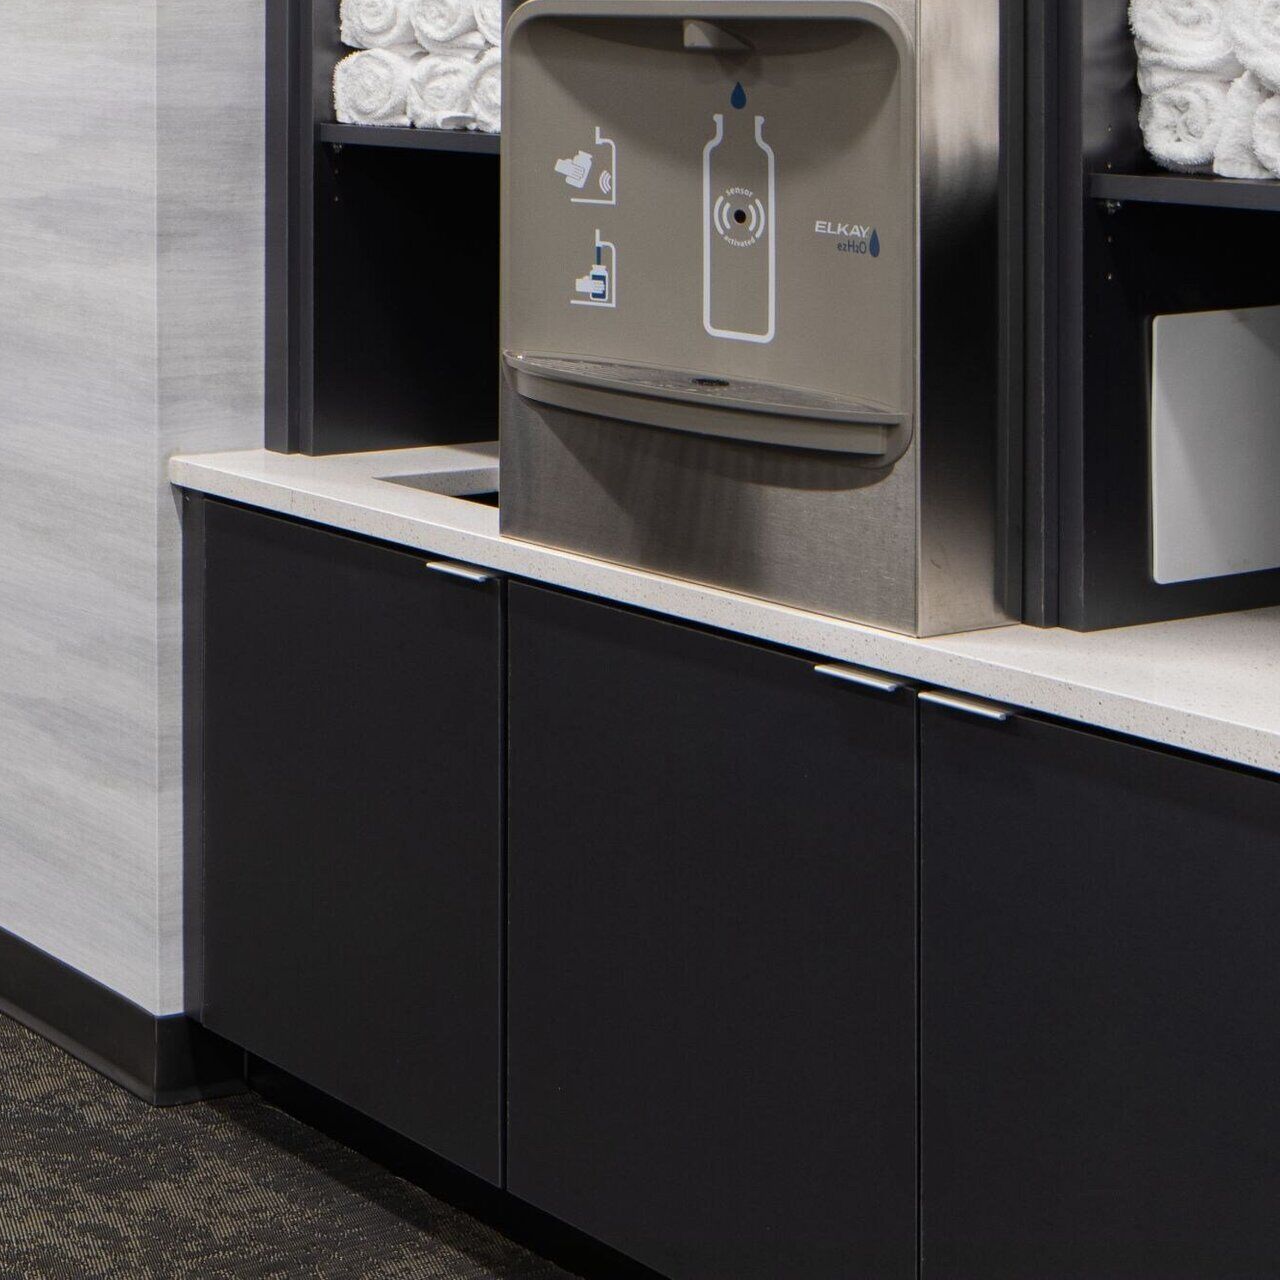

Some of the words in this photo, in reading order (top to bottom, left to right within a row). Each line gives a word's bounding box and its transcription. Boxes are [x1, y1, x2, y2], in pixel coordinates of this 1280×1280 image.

[725, 187, 754, 197] sensor
[815, 220, 870, 238] ELKAY
[724, 235, 756, 248] activated
